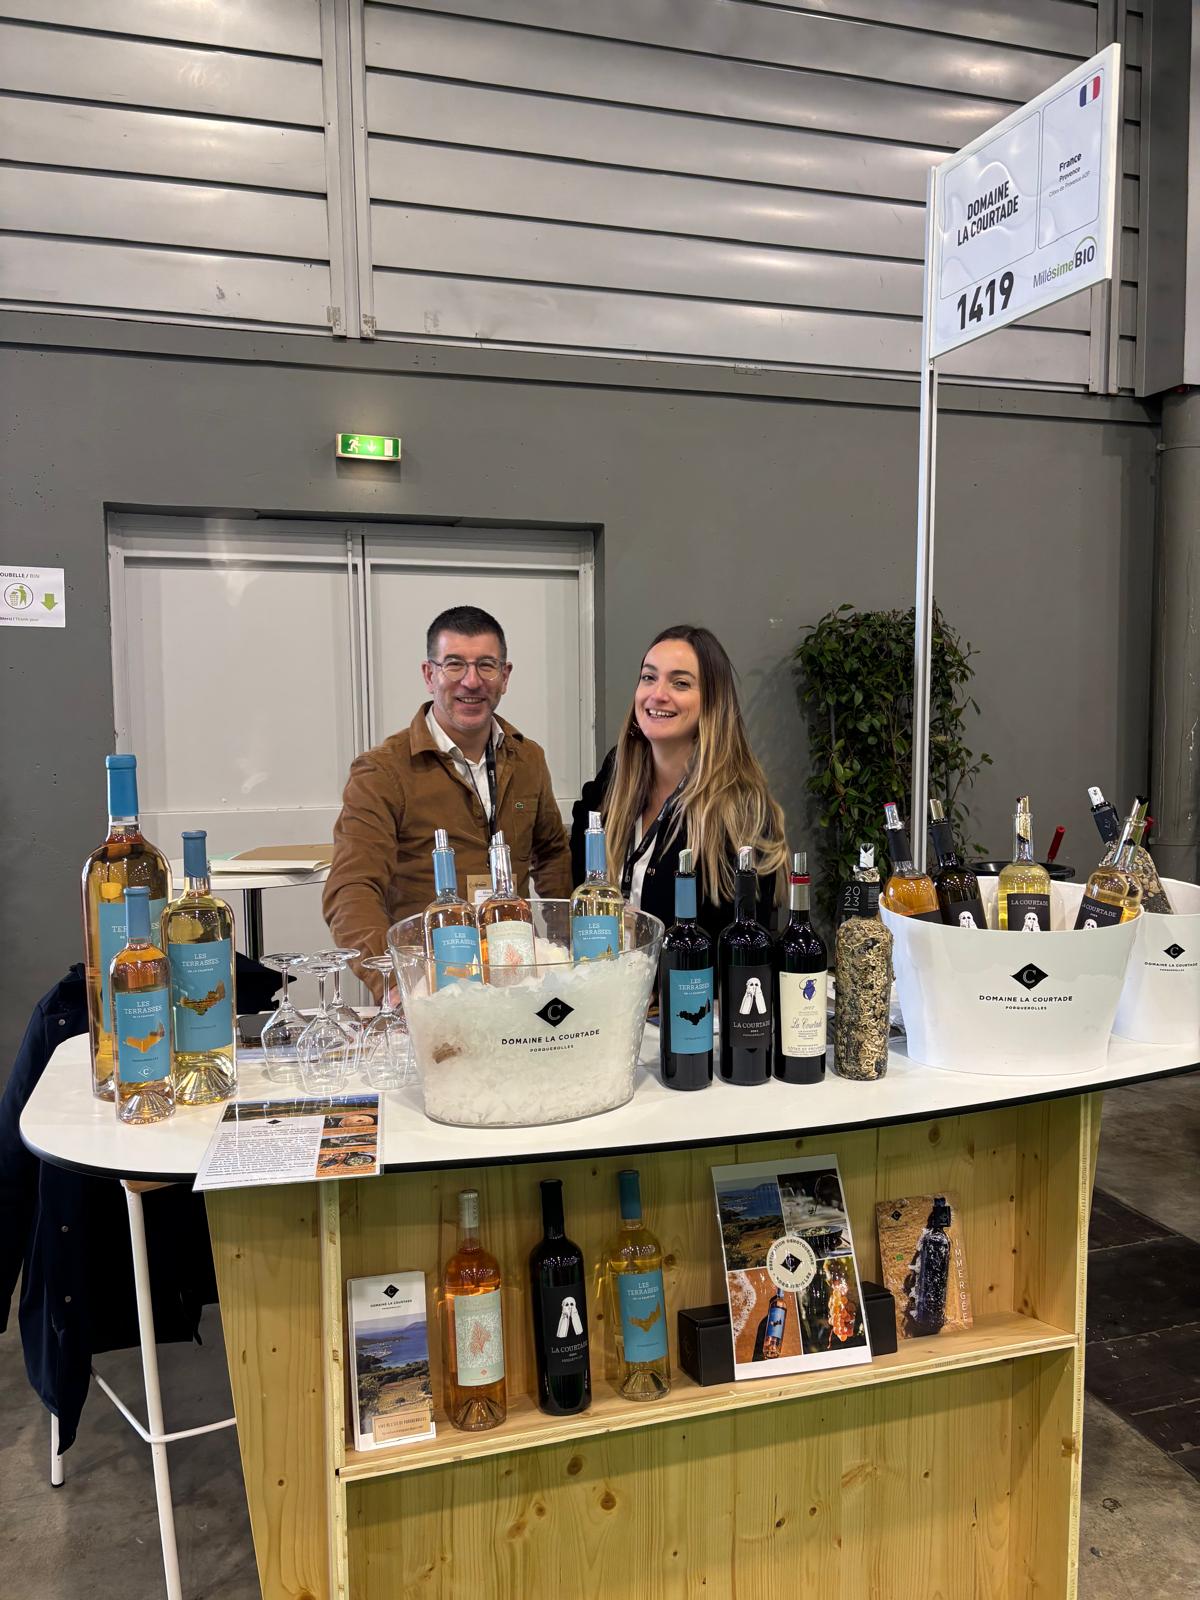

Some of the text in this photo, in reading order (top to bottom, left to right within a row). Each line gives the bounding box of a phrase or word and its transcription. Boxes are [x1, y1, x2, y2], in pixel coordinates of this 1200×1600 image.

[1059, 153, 1082, 172] France
[1059, 166, 1081, 182] Provence
[967, 180, 1010, 221] DOMAINE
[957, 195, 1019, 247] LA COURTADE
[956, 271, 1015, 331] 1419
[845, 886, 860, 896] 20
[844, 896, 860, 906] 23
[1086, 904, 1117, 918] COURTADE
[1170, 946, 1179, 956] C
[1022, 970, 1036, 984] C
[124, 1004, 163, 1015] TERRASSES
[547, 1004, 562, 1021] C
[502, 1036, 543, 1046] DOMAINE
[558, 1028, 600, 1041] COURTADE
[530, 1044, 574, 1053] PORQUEROLLES
